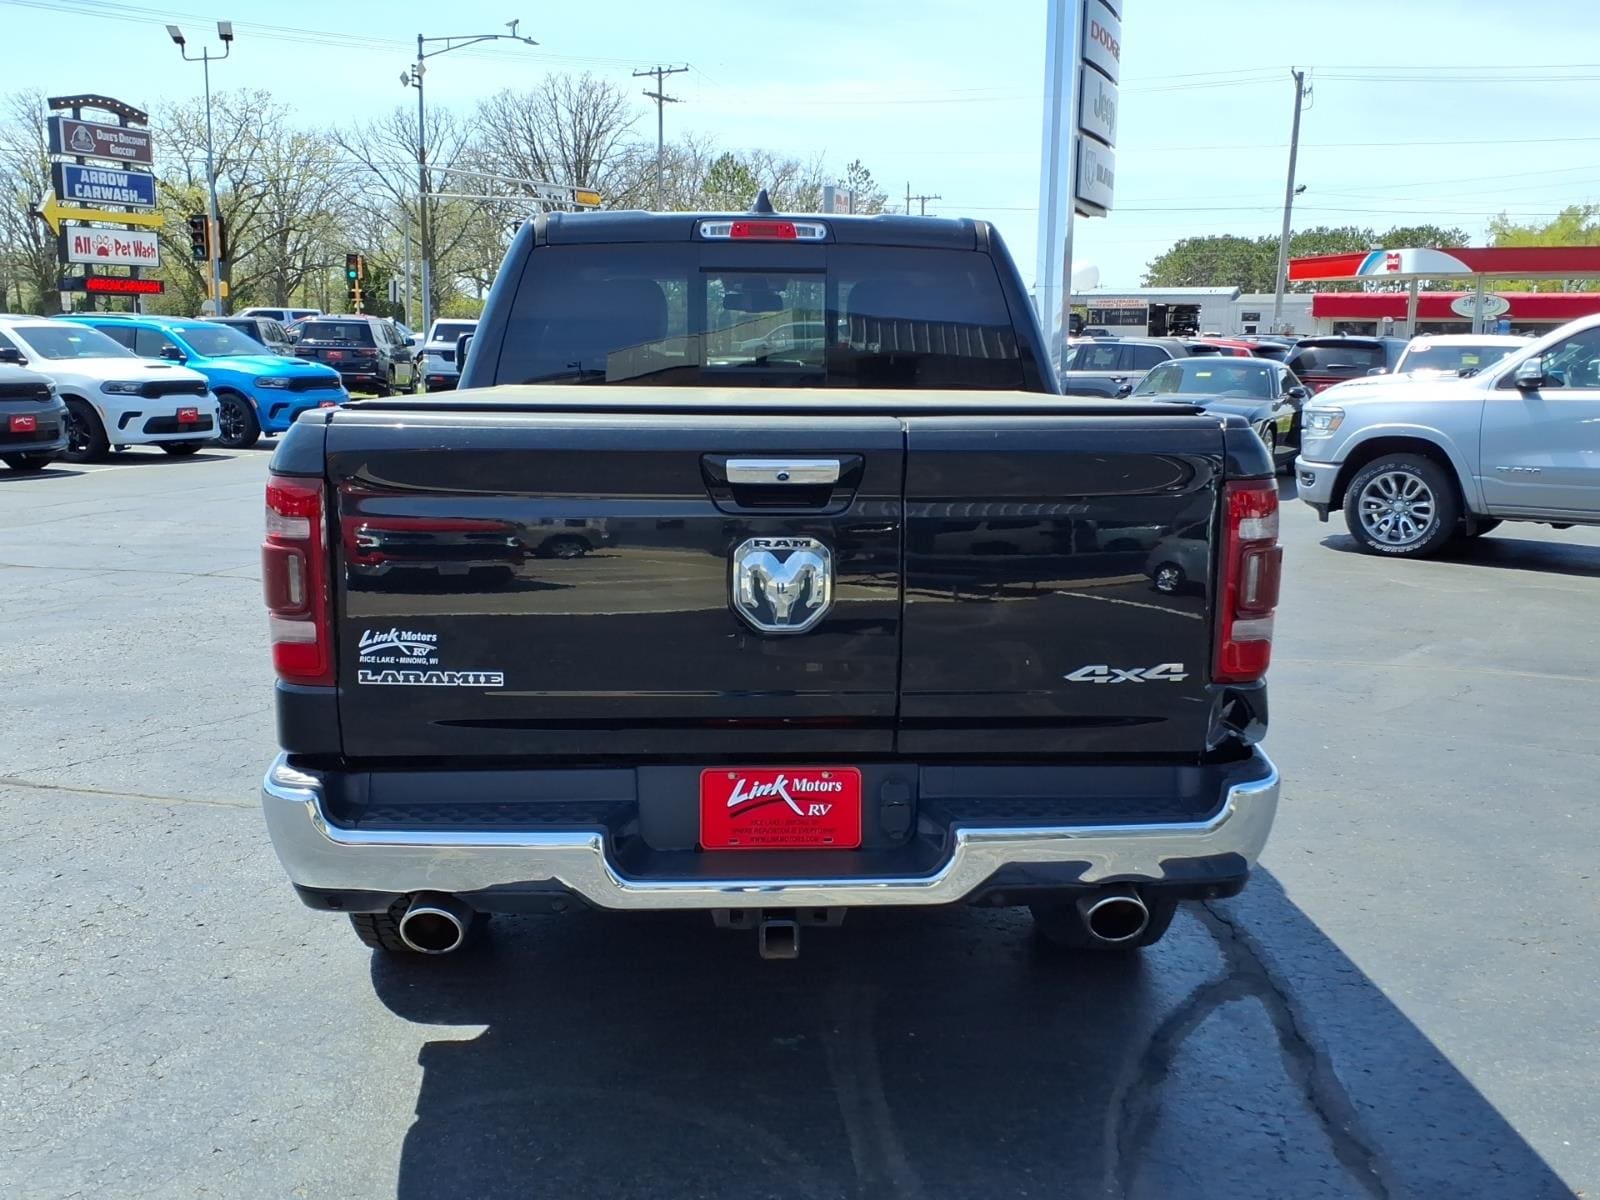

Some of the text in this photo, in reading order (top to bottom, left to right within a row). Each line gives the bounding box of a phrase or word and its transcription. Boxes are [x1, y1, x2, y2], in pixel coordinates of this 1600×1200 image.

[1094, 81, 1116, 135] Jeep
[109, 143, 136, 157] GROCERY
[80, 169, 128, 187] ARROW
[74, 183, 138, 203] CARWASH
[74, 236, 157, 258] All Pet Wash
[753, 540, 811, 548] RAM
[359, 628, 438, 654] Link Motors
[359, 655, 439, 666] RICE LAKE MINONG, WI
[412, 648, 430, 656] RV
[358, 670, 504, 687] LARAMIE
[727, 774, 843, 816] Link Motors
[807, 803, 832, 816] RV
